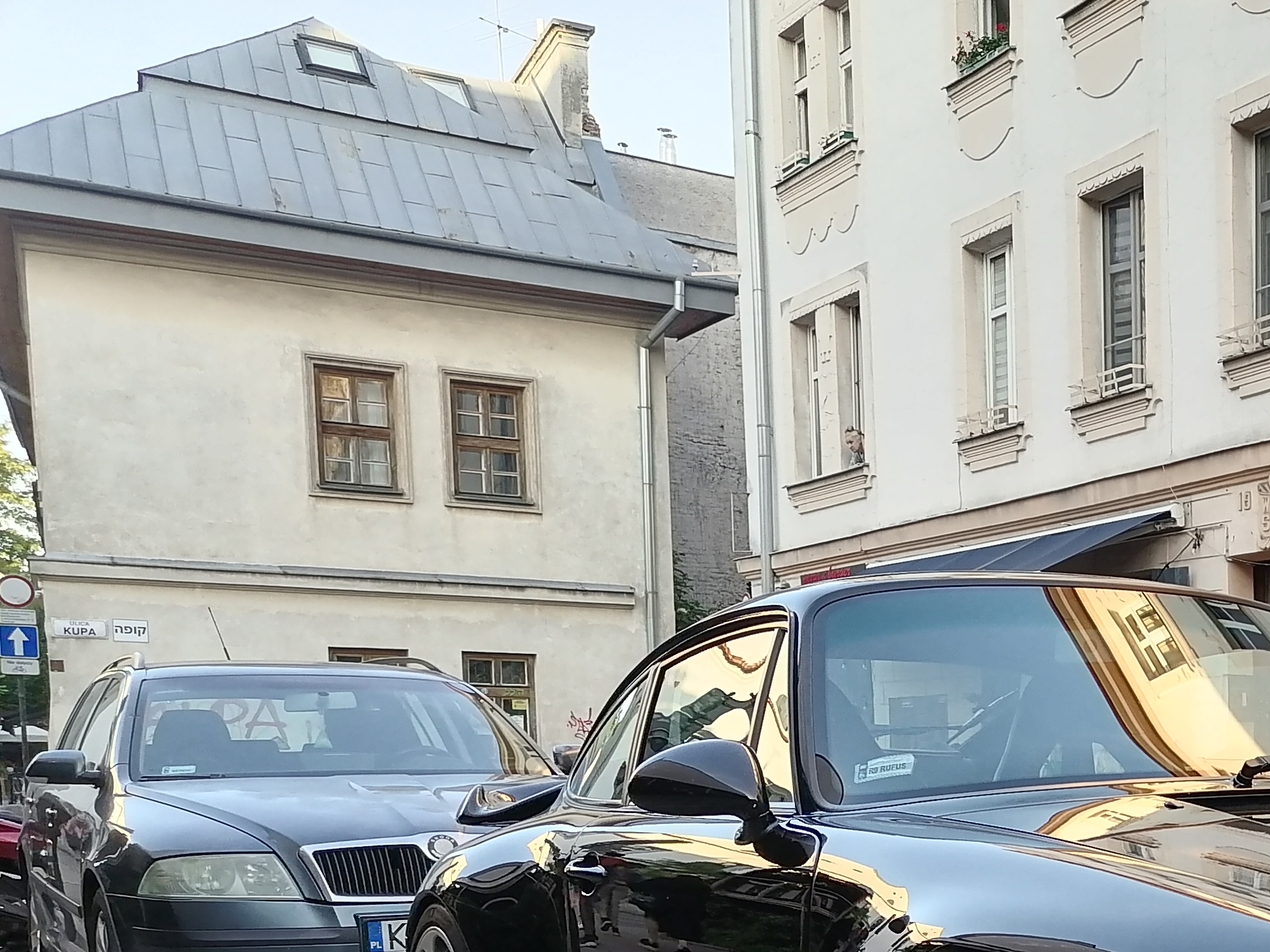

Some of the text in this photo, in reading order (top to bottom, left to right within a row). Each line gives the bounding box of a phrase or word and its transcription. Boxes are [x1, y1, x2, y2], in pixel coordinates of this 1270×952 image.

[63, 626, 97, 636] KUPA
[114, 625, 147, 637] קופה
[880, 762, 907, 773] RUFUS
[370, 941, 382, 949] PL
